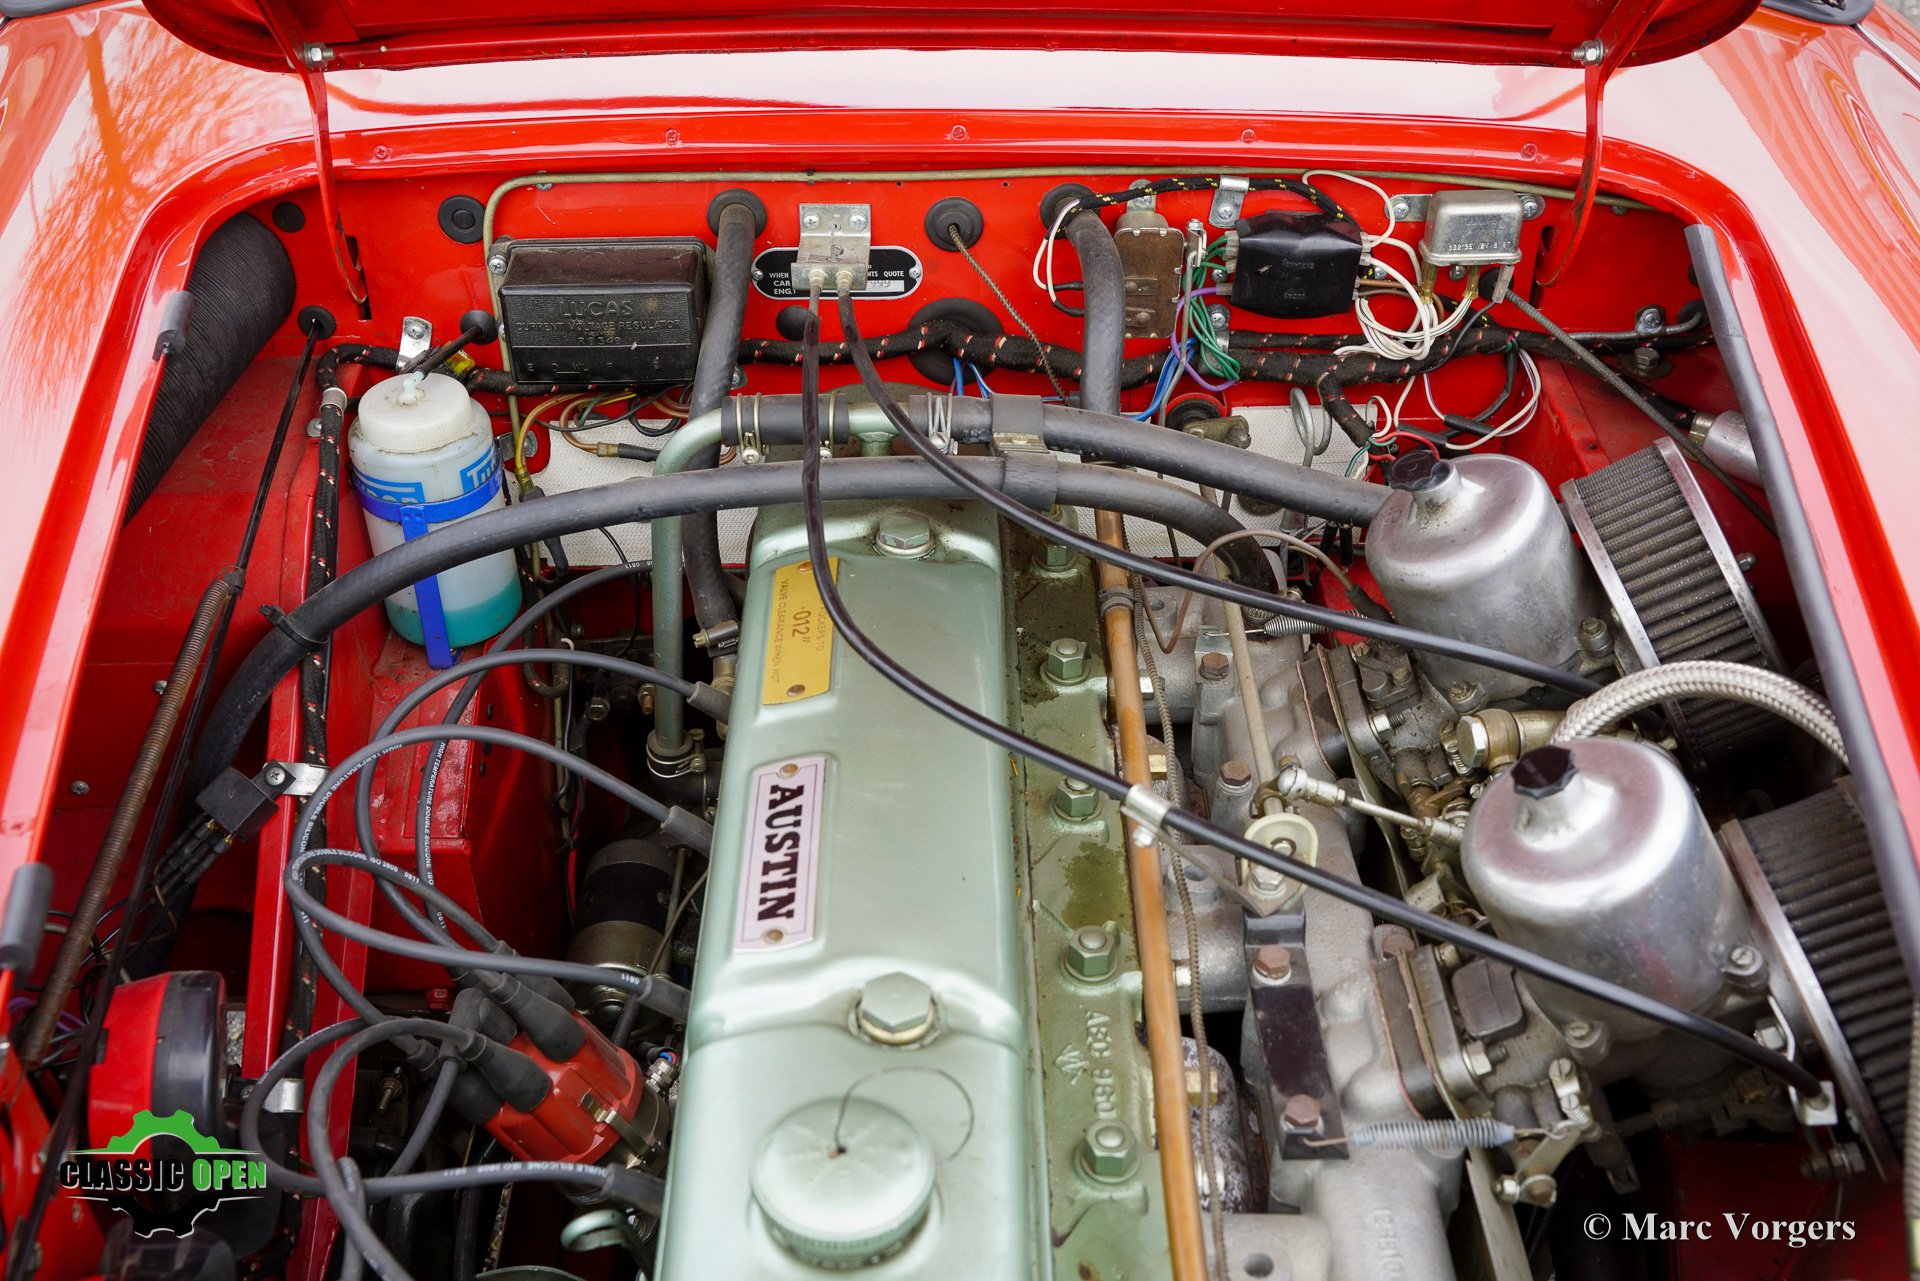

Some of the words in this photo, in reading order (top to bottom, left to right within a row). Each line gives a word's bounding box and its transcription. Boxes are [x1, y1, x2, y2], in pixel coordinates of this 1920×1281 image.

[560, 300, 634, 317] LUCAS
[515, 322, 565, 331] CURRENT
[568, 320, 616, 331] VOLTAGE
[619, 319, 682, 330] REGULATOR
[778, 579, 790, 601] VALVE
[774, 602, 787, 643] CLEARANCE
[771, 667, 781, 683] HOT
[436, 742, 446, 759] HIGH
[330, 752, 381, 791] TEMPERATURE
[426, 758, 441, 805] TEMPERATURE
[310, 791, 332, 820] DOUBLE
[424, 835, 432, 868] SILICONE
[757, 784, 805, 921] AUSTIN
[1085, 1010, 1113, 1058] AEC
